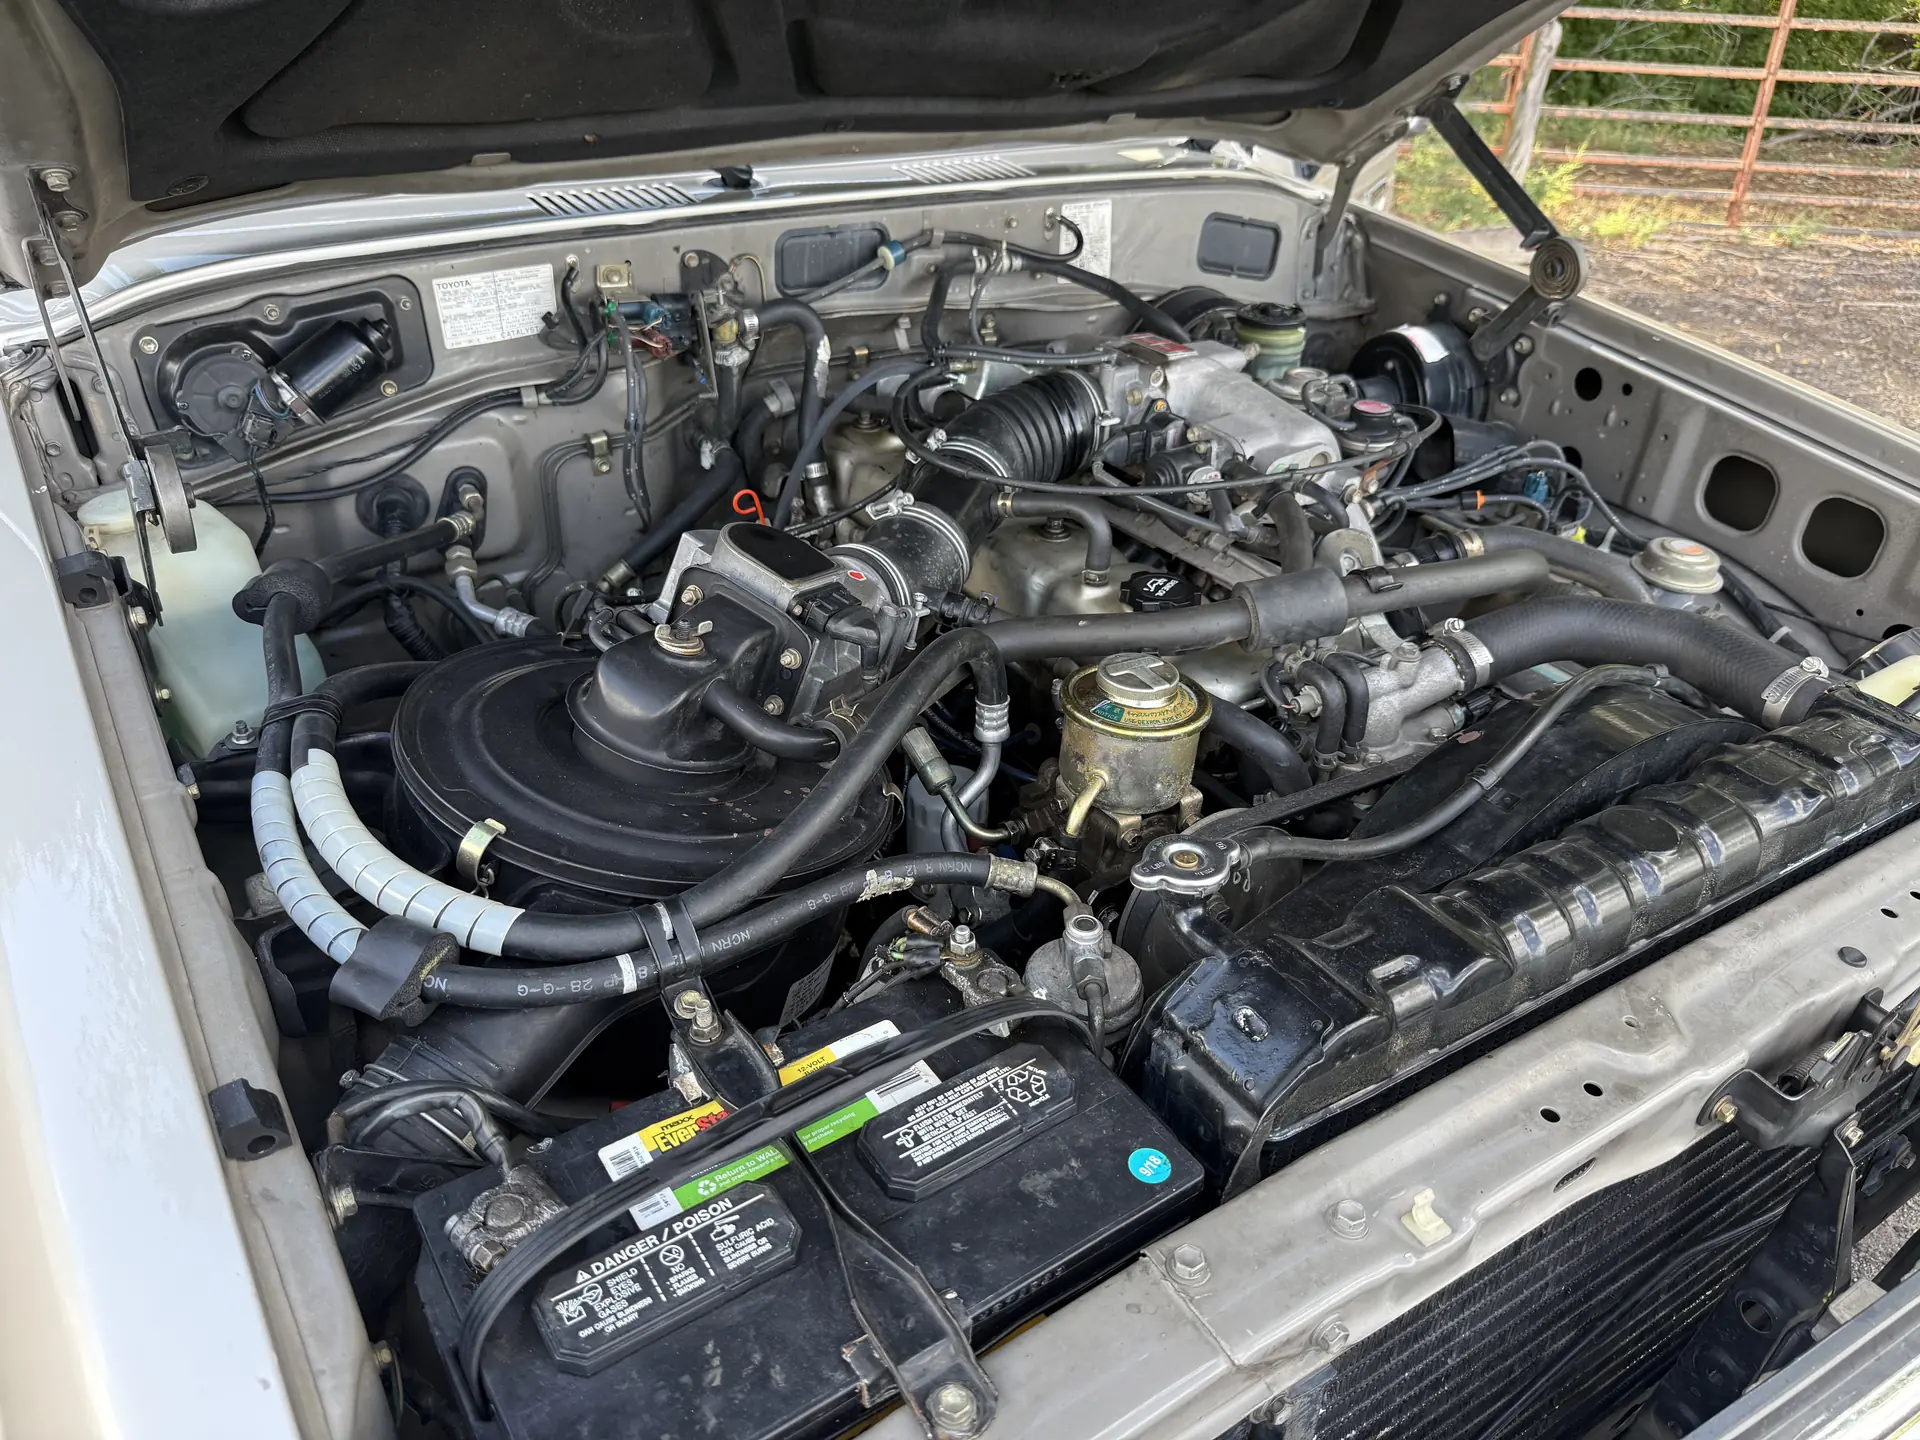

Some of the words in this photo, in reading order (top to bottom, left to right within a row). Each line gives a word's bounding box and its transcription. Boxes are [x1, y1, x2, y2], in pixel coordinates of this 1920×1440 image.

[436, 280, 472, 290] TOYOTA
[500, 326, 540, 339] CATALYST
[1094, 708, 1118, 720] NOTICE
[711, 928, 752, 954] NCRN
[423, 974, 448, 992] NC
[797, 1056, 826, 1074] 12-VOLT
[914, 1103, 926, 1111] KEEP
[954, 1082, 970, 1091] REACH
[977, 1067, 999, 1080] CHILDREN
[961, 1085, 973, 1094] CAPS
[997, 1066, 1011, 1075] LEVEL
[913, 1118, 933, 1131] FLUSH
[932, 1110, 948, 1120] EYES
[947, 1091, 983, 1113] IMMEDIATELY
[1029, 1094, 1050, 1107] RECYCLE
[653, 1110, 730, 1153] EverSta
[660, 1114, 695, 1131] maxx
[811, 1124, 829, 1136] proper
[830, 1112, 855, 1126] recycling
[917, 1125, 933, 1135] WITH
[955, 1107, 967, 1116] GET
[921, 1125, 947, 1140] MEDICAL
[947, 1116, 962, 1127] HELP
[962, 1109, 976, 1120] FAST
[808, 1129, 833, 1144] purchase
[714, 1165, 745, 1181] Return
[755, 1149, 777, 1161] WAL
[719, 1178, 730, 1187] and
[731, 1170, 748, 1181] credit
[748, 1160, 769, 1172] toward
[1138, 1155, 1162, 1177] 9/18
[591, 1235, 658, 1274] DANGER
[662, 1227, 668, 1241] /
[672, 1198, 732, 1233] POISON
[716, 1228, 754, 1250] SULFURIC
[756, 1218, 774, 1231] ACID
[720, 1247, 734, 1256] CAN
[734, 1235, 756, 1249] CAUSE
[723, 1243, 757, 1262] BLINDNESS
[757, 1237, 768, 1245] OR
[727, 1254, 750, 1269] SEVERE
[750, 1243, 771, 1256] BURNS
[606, 1268, 637, 1286] SHIELD
[669, 1267, 695, 1283] SPARKS
[670, 1263, 685, 1273] NO
[610, 1279, 633, 1294] EYES
[672, 1273, 698, 1289] FLAMES
[676, 1278, 705, 1295] SMOKING
[594, 1283, 641, 1311] EXPLOSIVE
[579, 1326, 594, 1337] CAN
[594, 1315, 616, 1329] CAUSE
[617, 1297, 652, 1318] BLINDNESS
[598, 1299, 628, 1318] GASES
[604, 1324, 615, 1332] OR
[615, 1312, 638, 1327] INJURY
